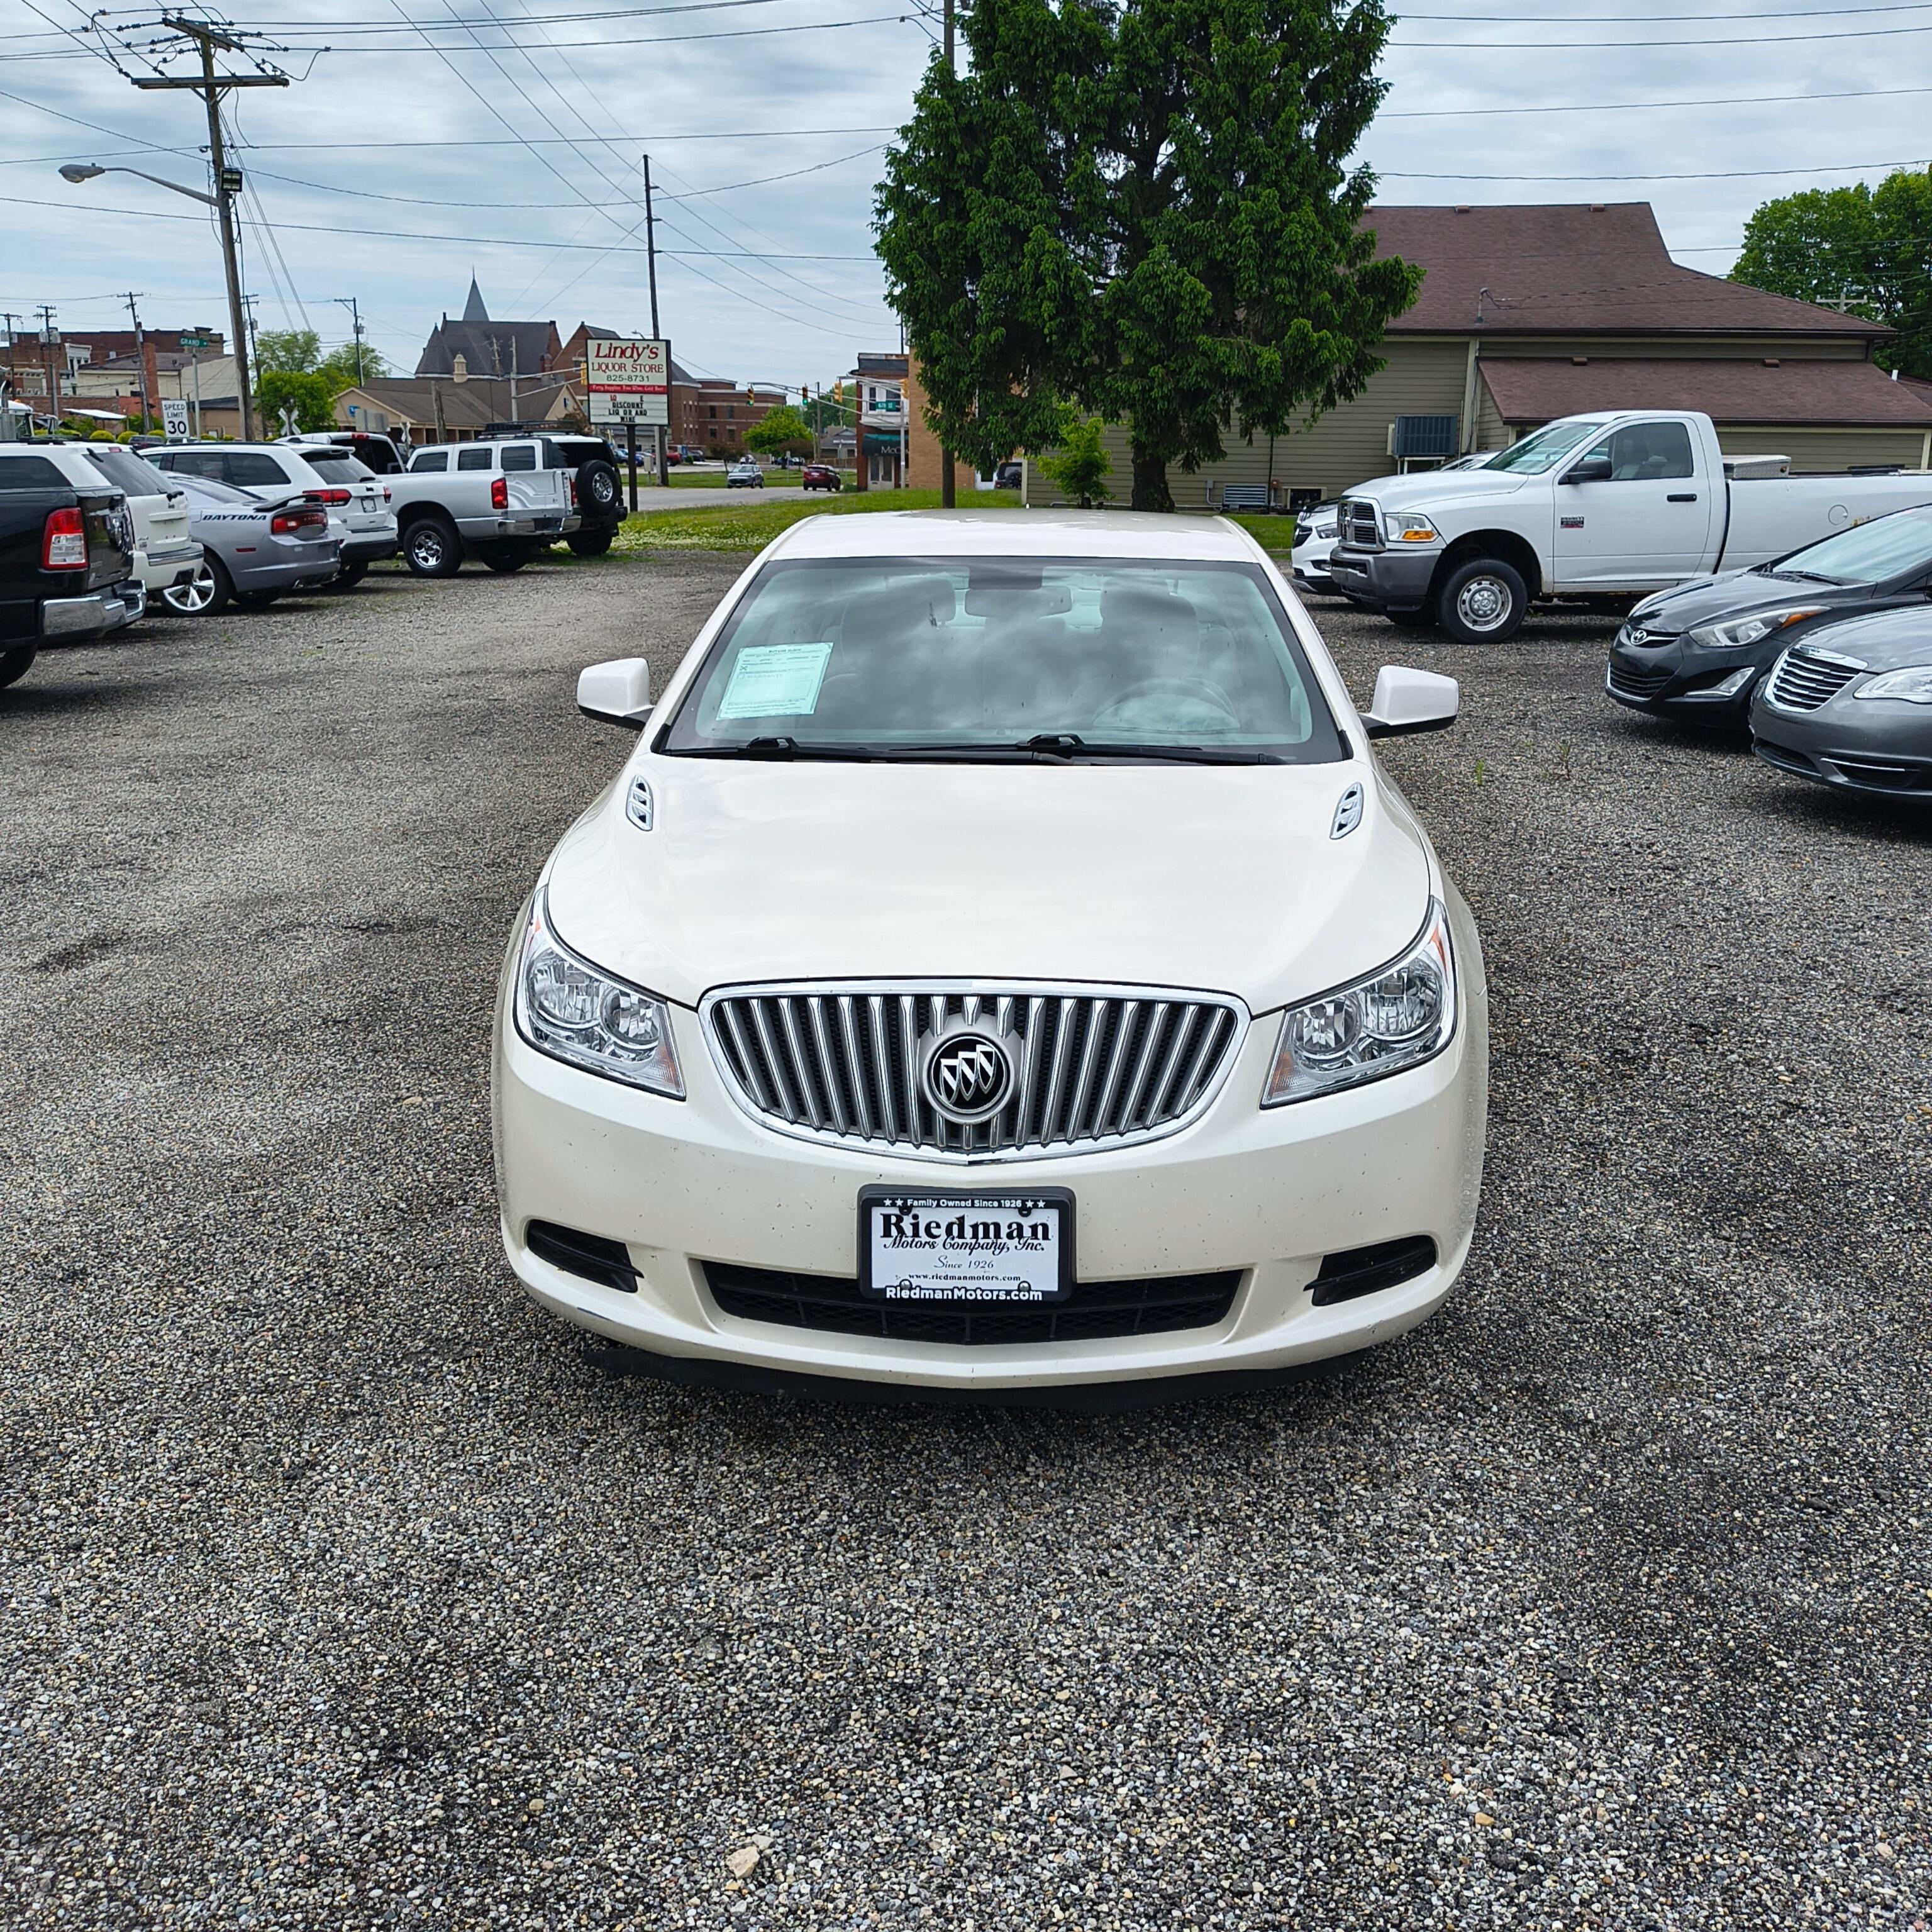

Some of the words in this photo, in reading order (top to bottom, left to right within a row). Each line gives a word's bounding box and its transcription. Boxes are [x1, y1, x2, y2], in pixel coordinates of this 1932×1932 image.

[180, 338, 200, 346] GRAND
[594, 342, 659, 362] Lindy's
[592, 362, 627, 373] LIQUOR
[631, 363, 664, 373] STORE
[168, 421, 187, 435] 30
[907, 1199, 937, 1208] Family
[940, 1199, 972, 1207] Owned
[974, 1199, 998, 1208] Since
[880, 1213, 1051, 1241] Riedman
[884, 1233, 938, 1249] Motors
[942, 1235, 1010, 1256] Company,
[1014, 1236, 1045, 1251] Inc.
[933, 1255, 963, 1269] Since
[968, 1260, 994, 1269] 1926
[886, 1287, 1043, 1301] RiedmanMotors.com
